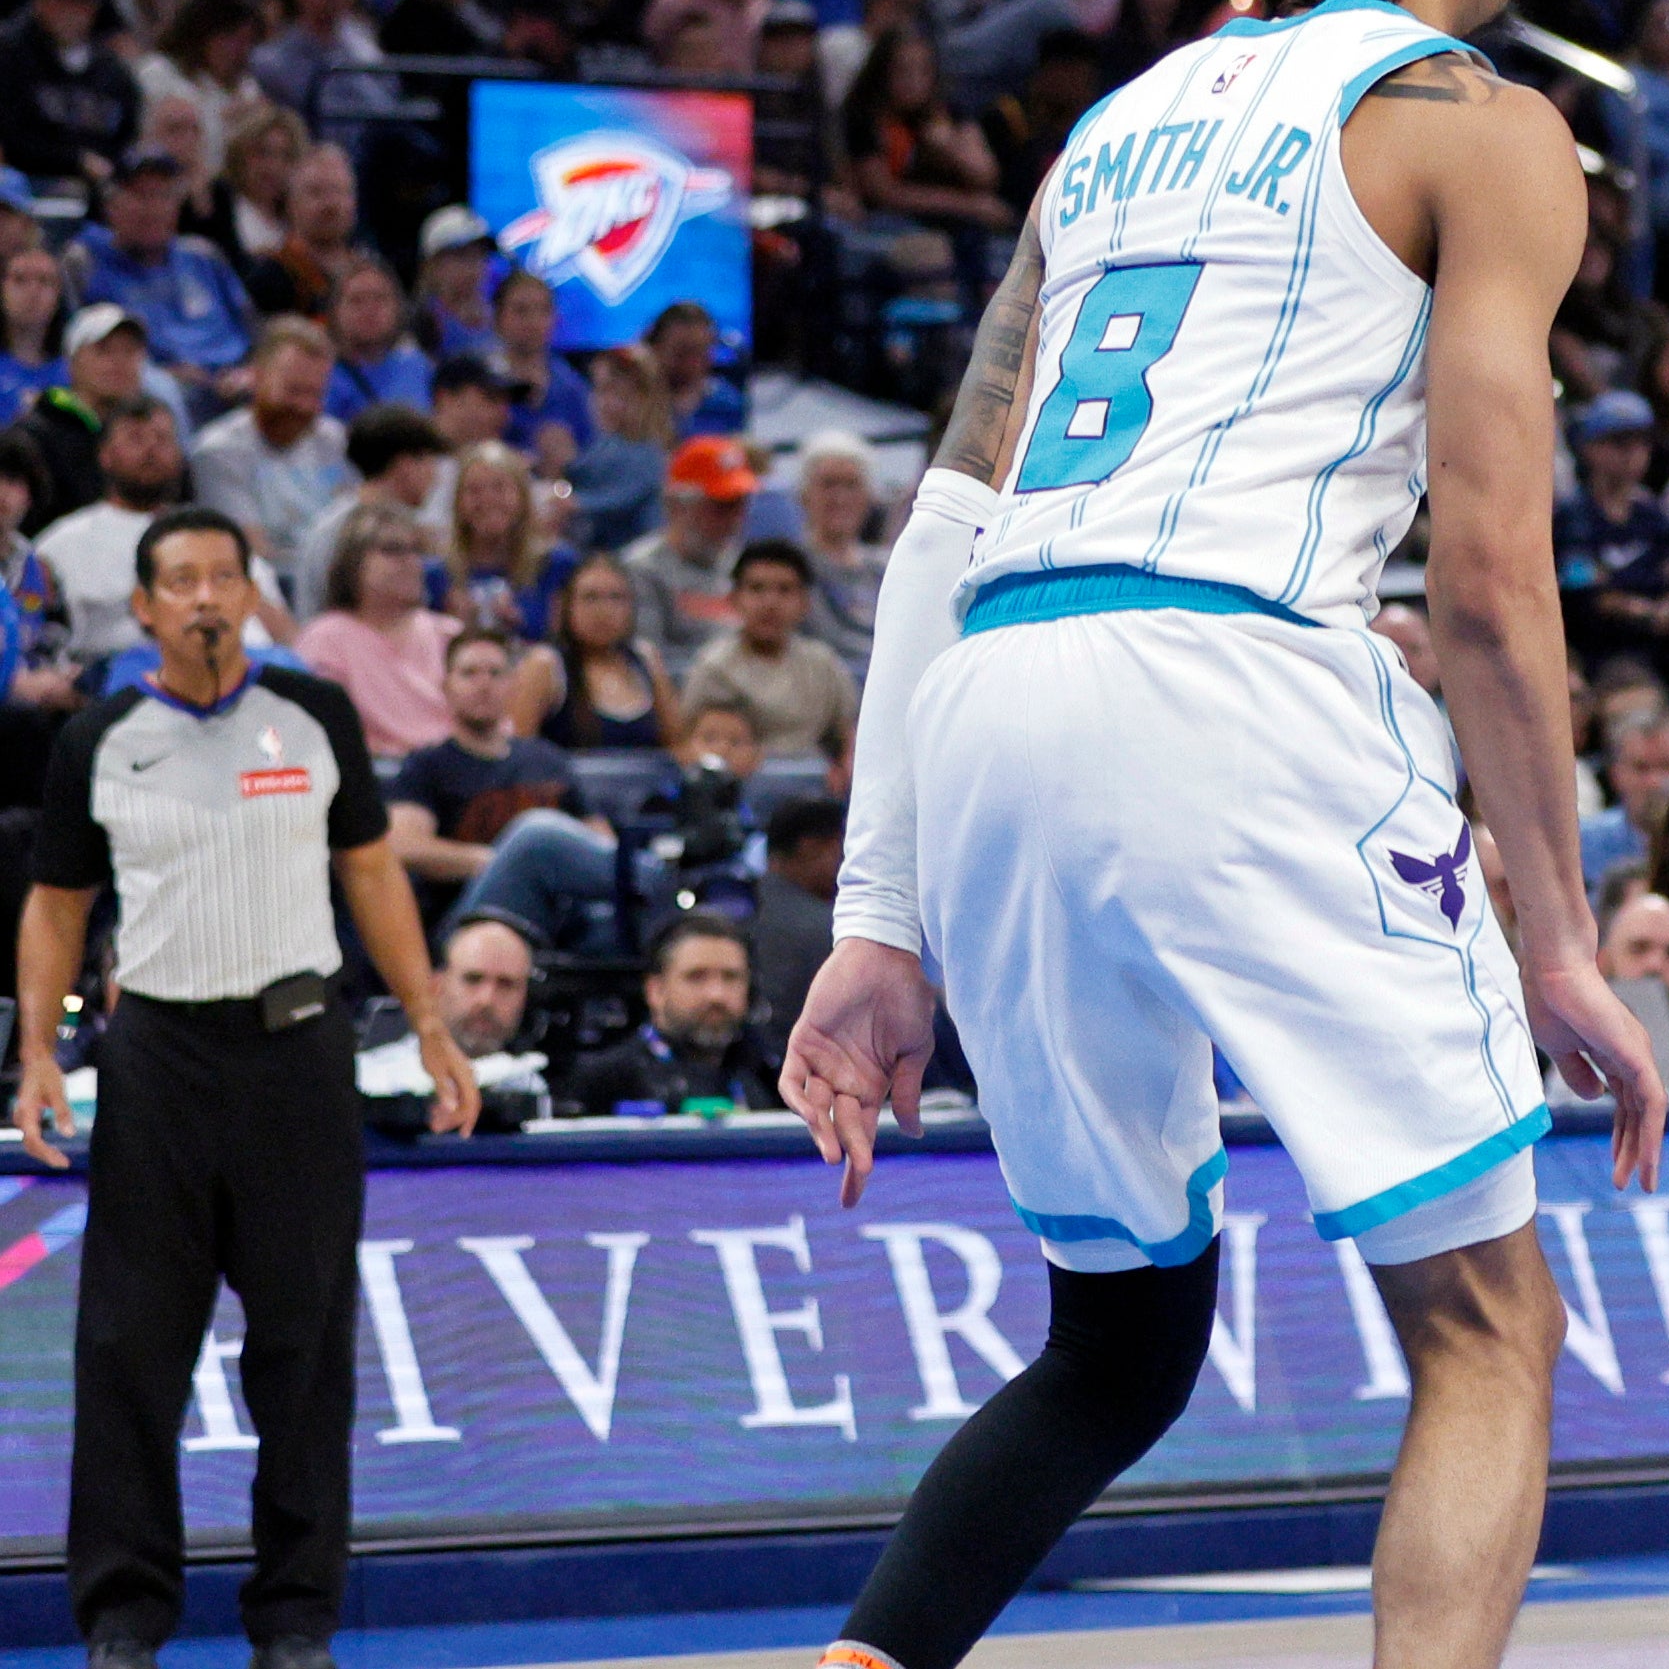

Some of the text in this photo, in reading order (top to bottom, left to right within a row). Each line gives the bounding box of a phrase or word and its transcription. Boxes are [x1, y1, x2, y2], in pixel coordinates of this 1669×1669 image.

[1059, 119, 1312, 229] SMITH JR.
[1013, 261, 1206, 495] 8
